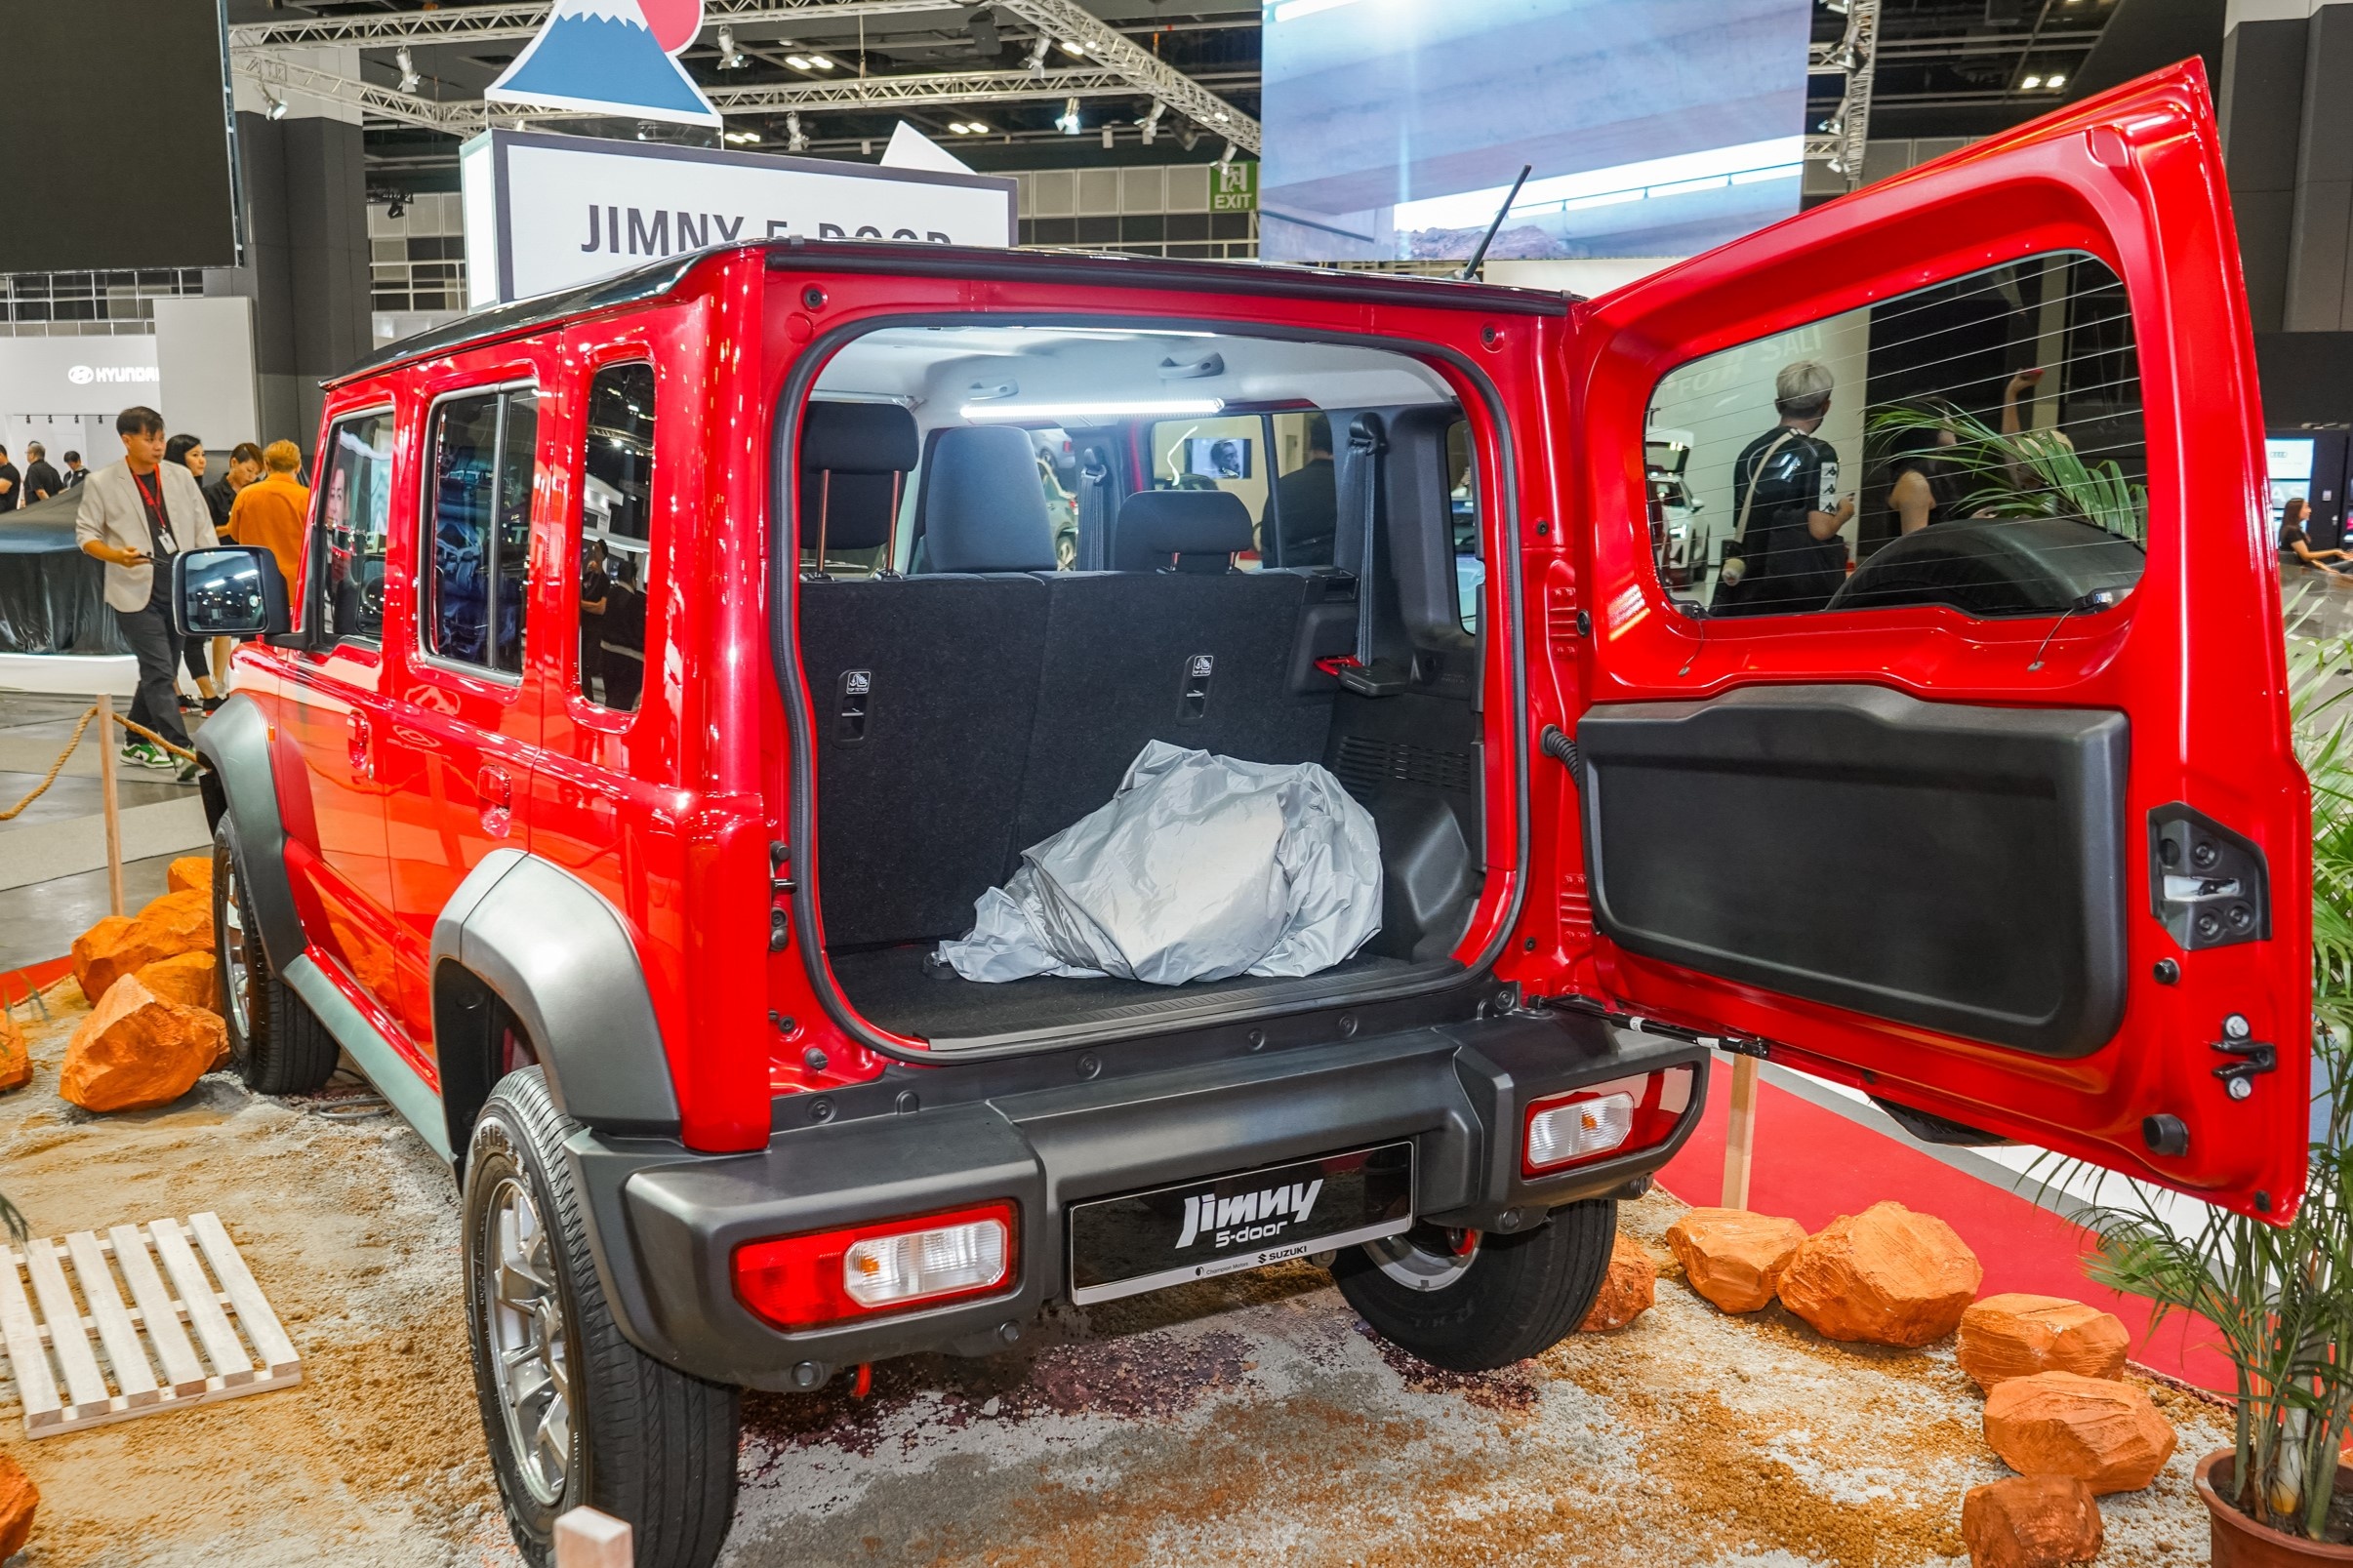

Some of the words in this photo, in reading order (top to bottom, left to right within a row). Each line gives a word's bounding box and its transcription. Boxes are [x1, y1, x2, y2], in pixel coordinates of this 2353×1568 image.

[1214, 193, 1252, 209] EXIT
[1215, 1221, 1288, 1249] 5-door
[1269, 1245, 1308, 1262] SUZUKI
[1205, 1265, 1233, 1275] Champion
[1232, 1261, 1249, 1269] Motors
